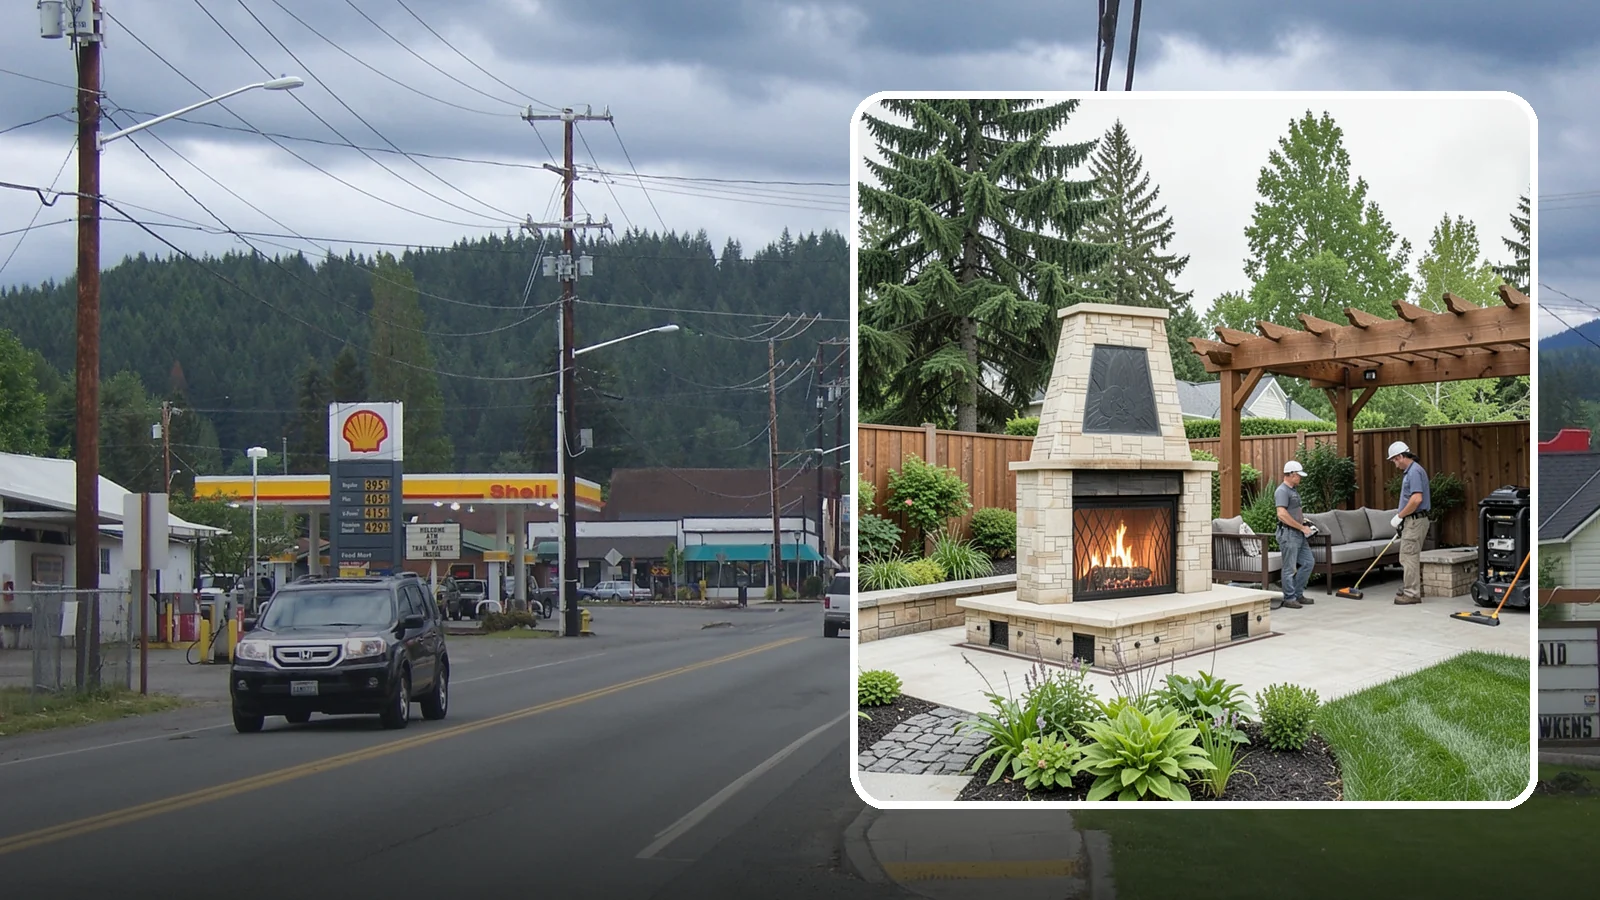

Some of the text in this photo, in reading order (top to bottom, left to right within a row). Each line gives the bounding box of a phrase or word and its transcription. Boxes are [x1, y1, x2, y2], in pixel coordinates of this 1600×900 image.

[365, 480, 383, 490] 395
[490, 484, 547, 499] Shell
[365, 494, 383, 504] 405
[365, 508, 383, 518] 415
[365, 522, 383, 532] 429
